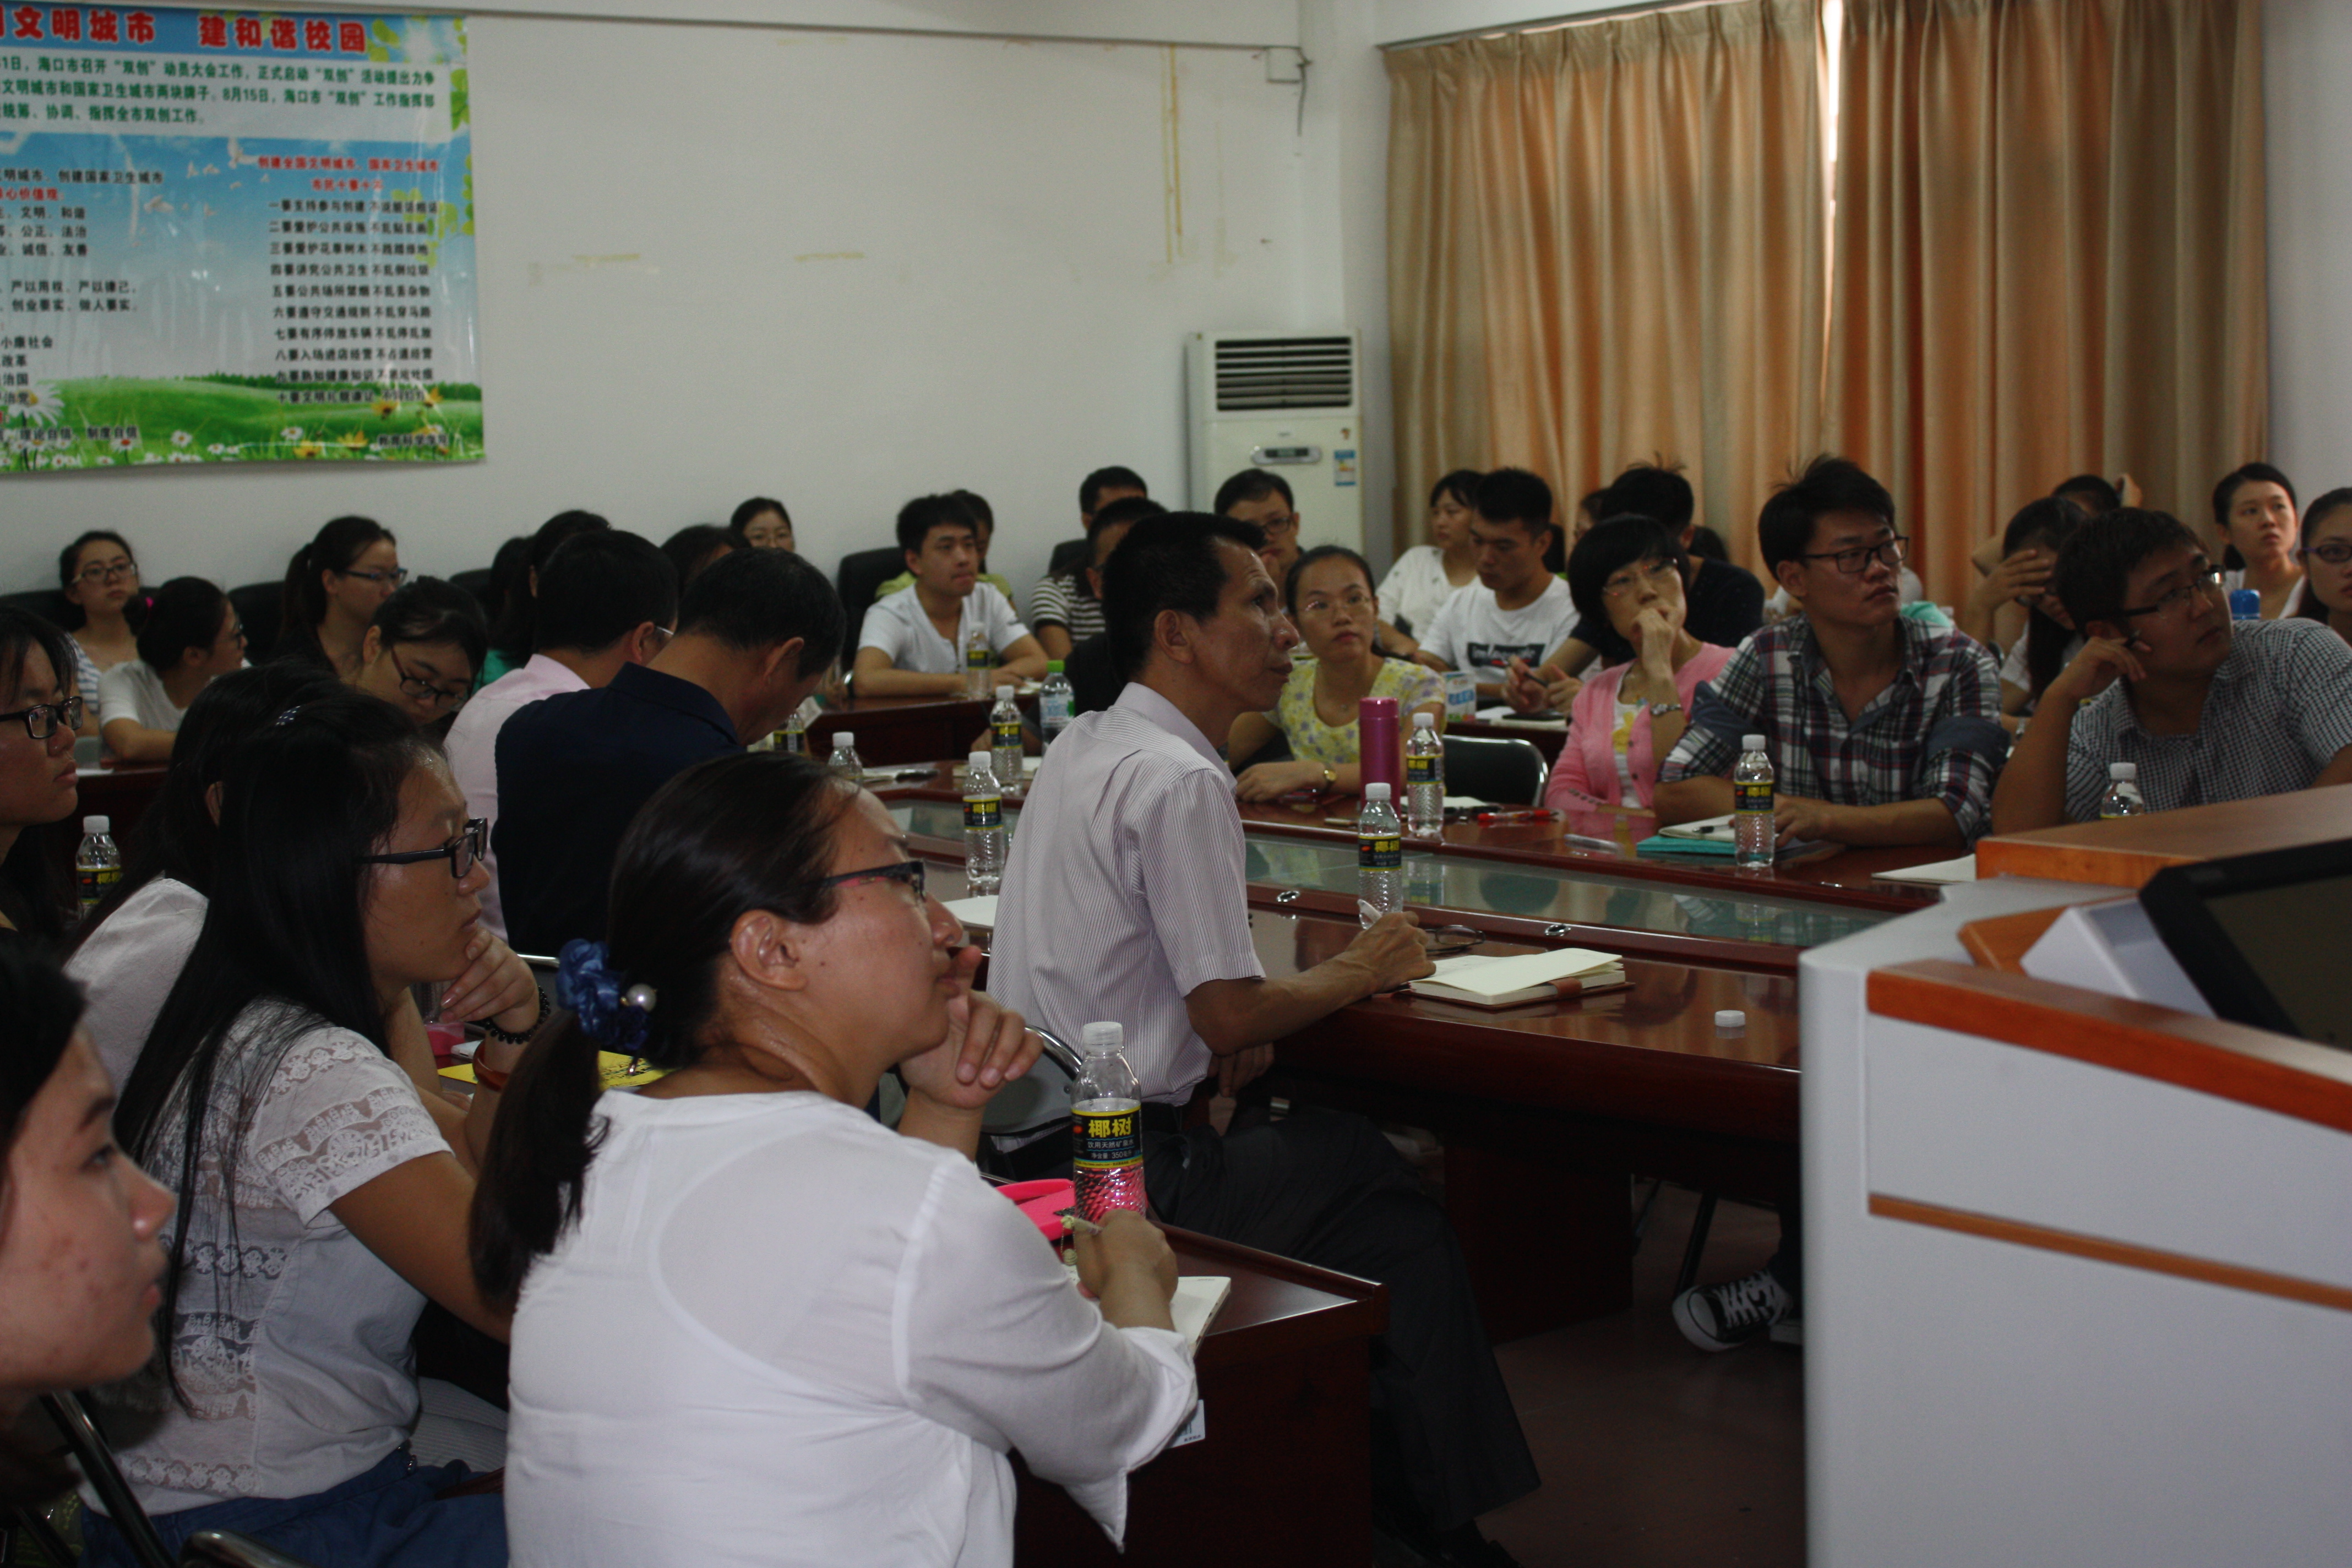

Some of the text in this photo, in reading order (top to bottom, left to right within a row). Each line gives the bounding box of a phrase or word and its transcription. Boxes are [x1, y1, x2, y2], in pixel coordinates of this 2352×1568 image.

[0, 4, 366, 54] 文明城市 建和谐校园
[0, 168, 163, 184] 明城市、创建国家卫生城市
[0, 206, 85, 219] 、文明、和谐
[1088, 1117, 1132, 1137] 椰树
[1087, 1139, 1134, 1149] 饮用天然矿泉水
